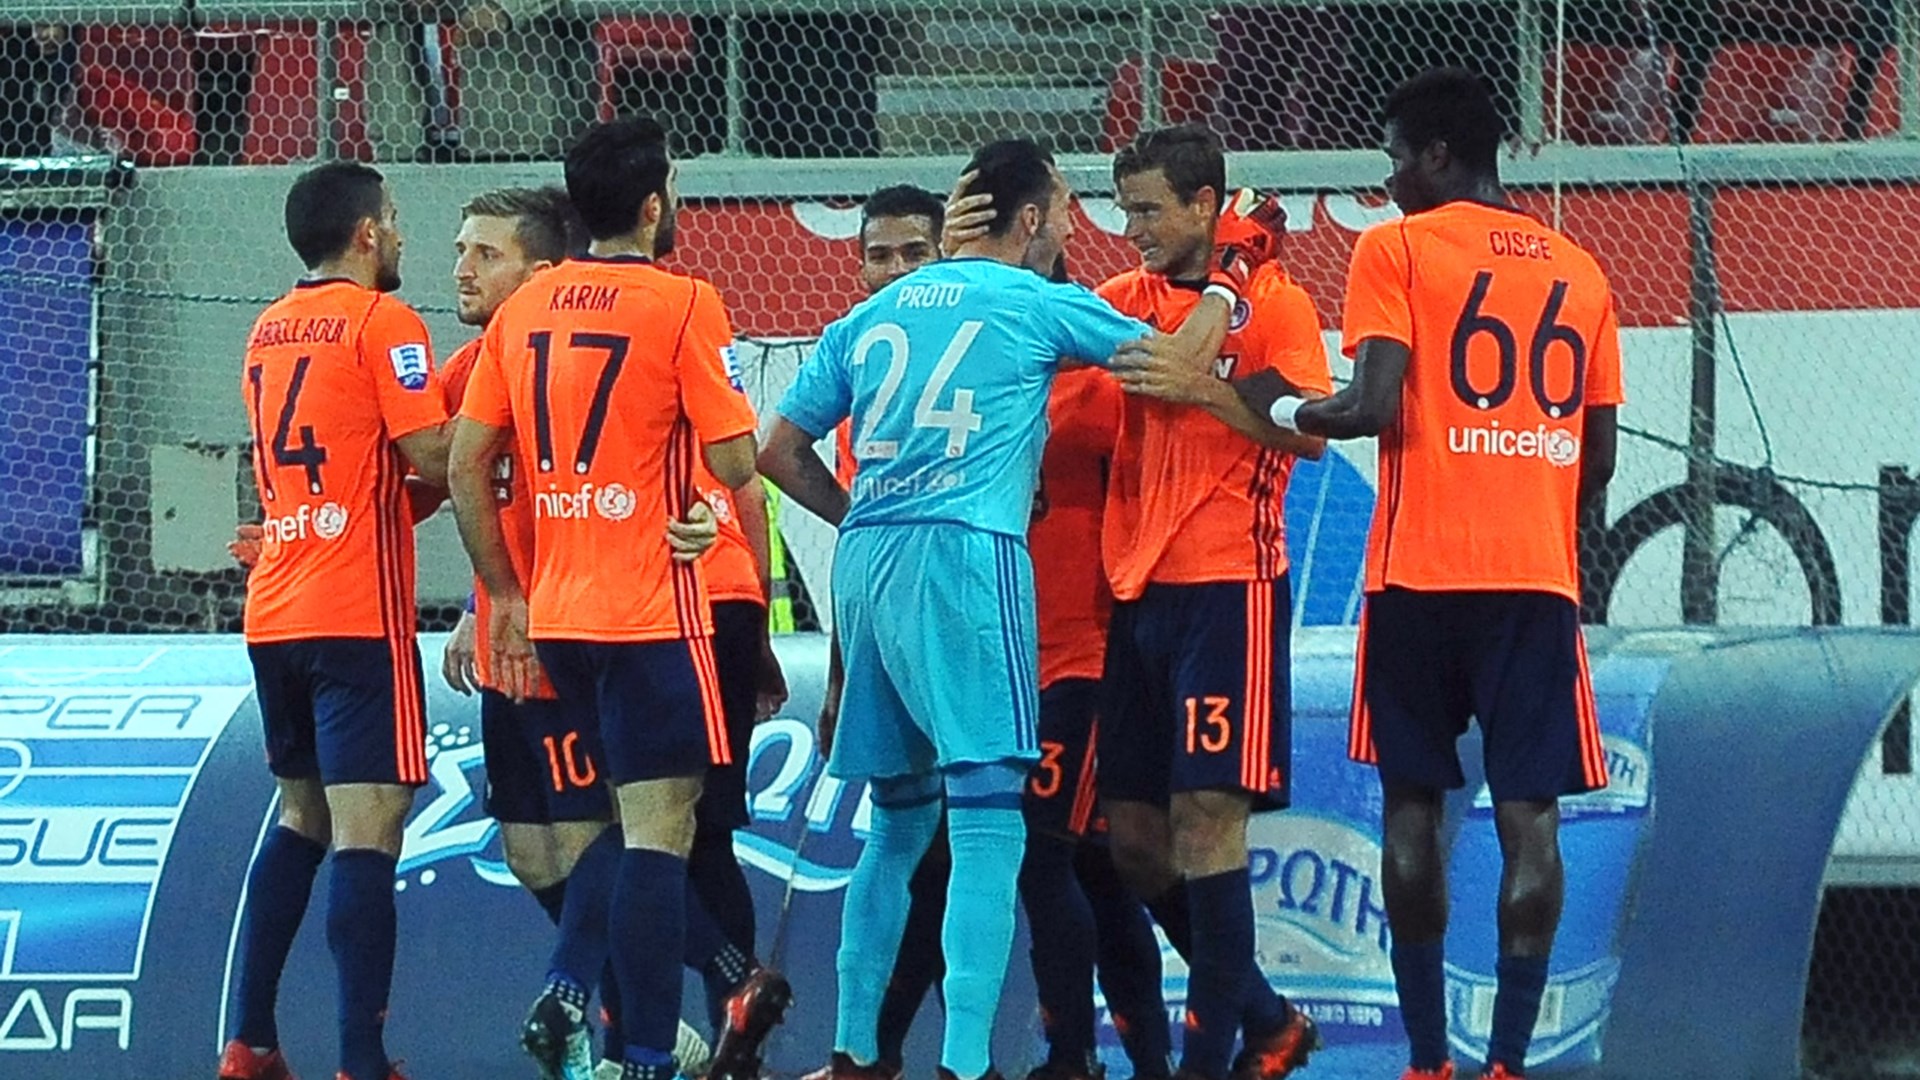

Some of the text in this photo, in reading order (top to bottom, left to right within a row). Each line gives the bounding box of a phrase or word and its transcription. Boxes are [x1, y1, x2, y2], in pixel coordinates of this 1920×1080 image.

[1489, 230, 1553, 261] CISSE
[549, 285, 619, 312] KARIM
[1449, 271, 1587, 418] 66
[527, 331, 630, 475] 17
[853, 321, 984, 459] 24
[249, 356, 325, 500] 14
[1448, 420, 1548, 458] unicef
[536, 483, 593, 519] nicef
[1185, 697, 1230, 753] 13
[543, 731, 596, 791] 10
